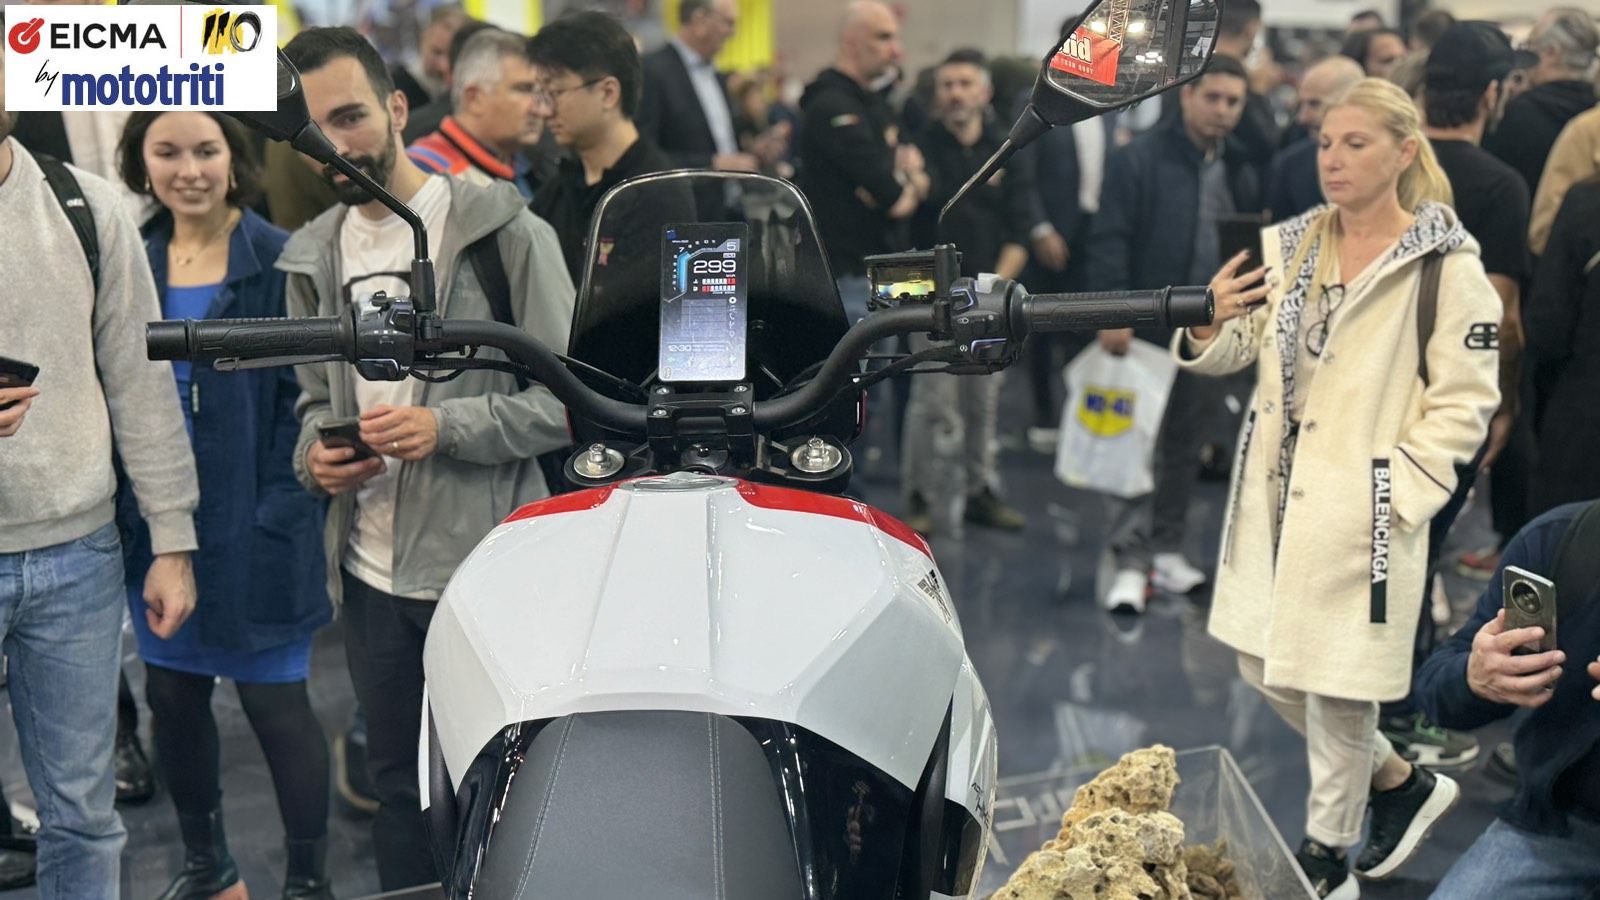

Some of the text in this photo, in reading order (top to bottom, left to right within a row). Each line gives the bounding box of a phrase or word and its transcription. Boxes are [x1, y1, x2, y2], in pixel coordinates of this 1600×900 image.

[726, 241, 737, 251] 5
[693, 259, 737, 274] 299
[1371, 467, 1391, 584] BALENCIAGA
